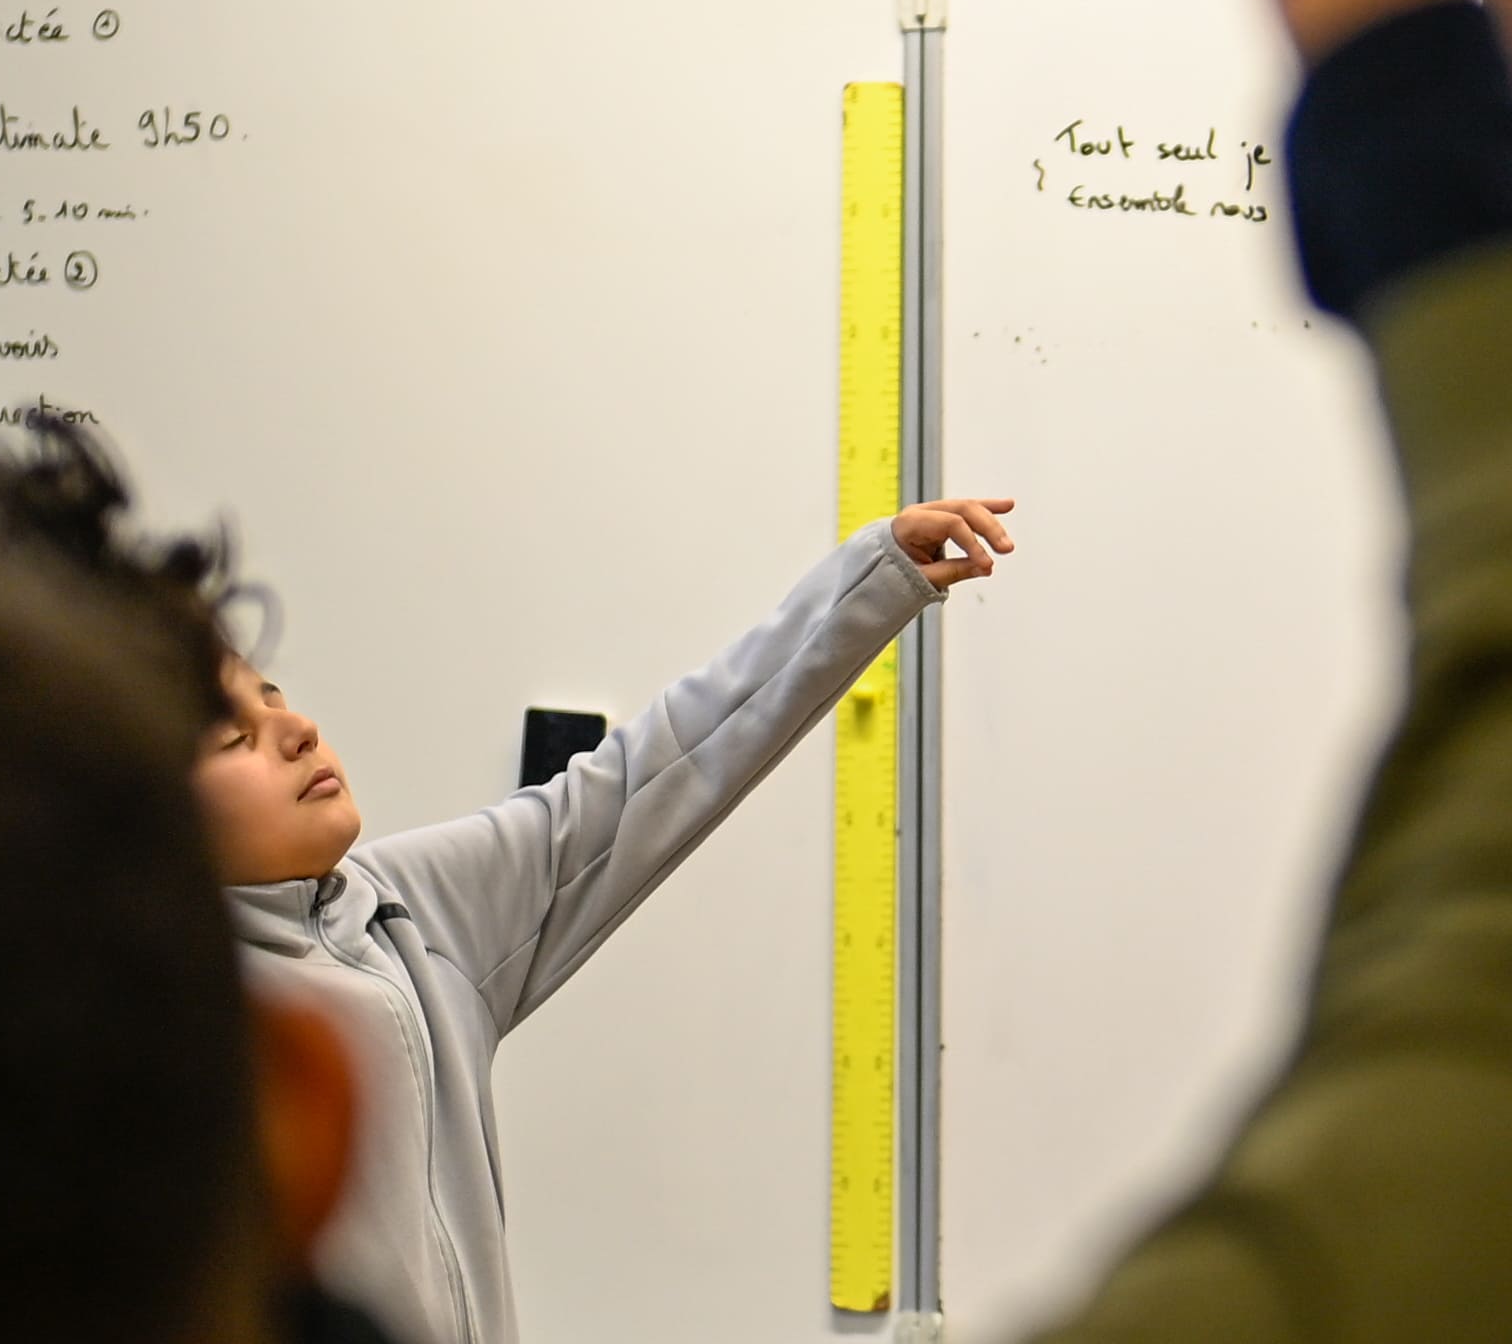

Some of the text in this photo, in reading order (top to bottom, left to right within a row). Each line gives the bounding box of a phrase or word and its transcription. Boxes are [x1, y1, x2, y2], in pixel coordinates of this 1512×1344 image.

[1054, 120, 1272, 191] Tout seul je
[1067, 184, 1198, 216] Ensemble
